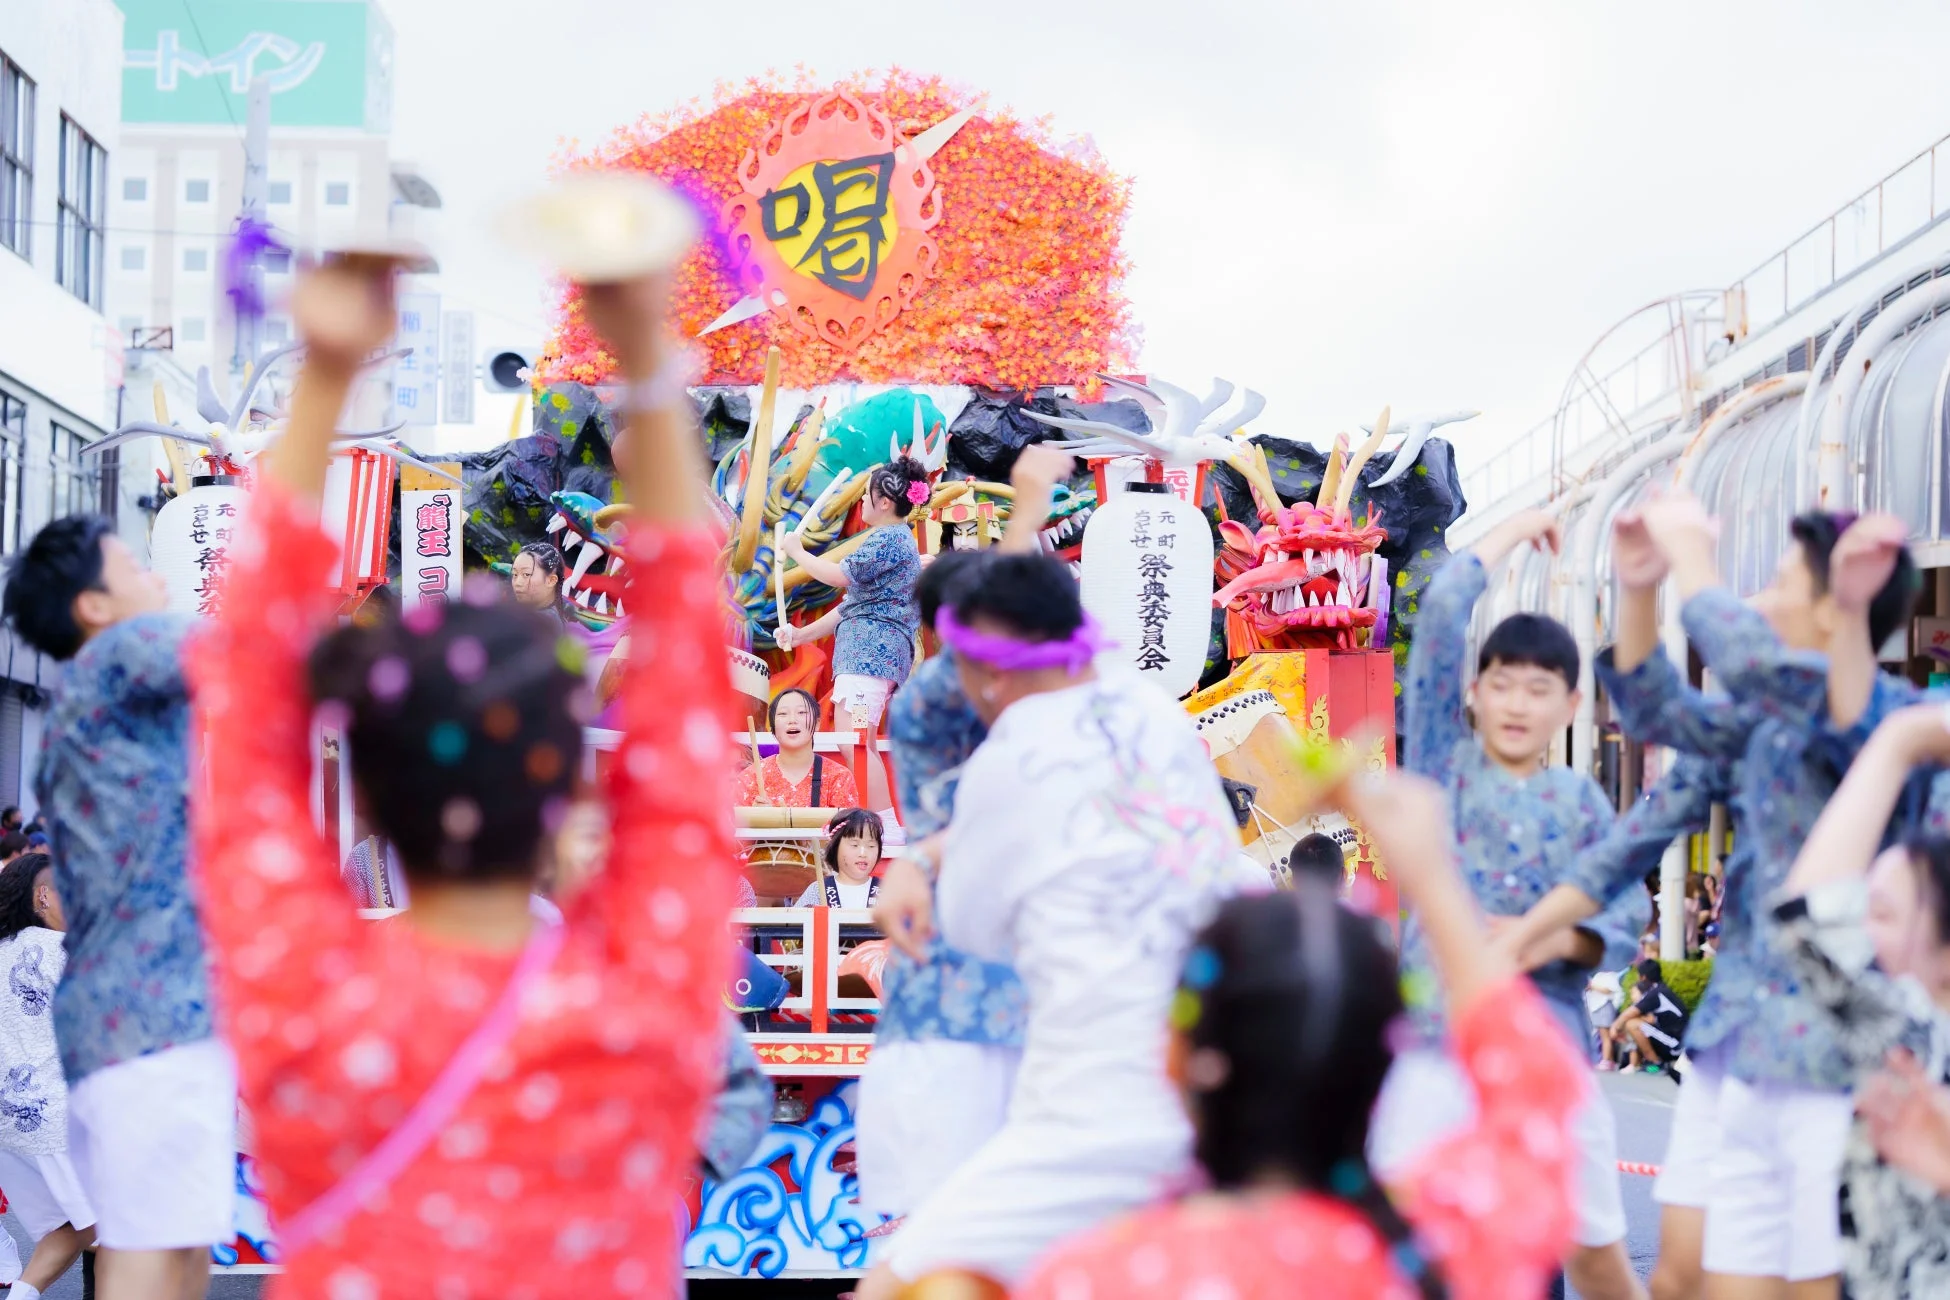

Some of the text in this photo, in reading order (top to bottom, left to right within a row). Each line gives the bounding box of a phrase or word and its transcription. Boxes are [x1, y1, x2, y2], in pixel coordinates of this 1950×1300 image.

[757, 151, 896, 302] 喝
[215, 503, 237, 544] 元町
[1157, 510, 1176, 549] 元町
[1136, 553, 1174, 672] 祭典委員会
